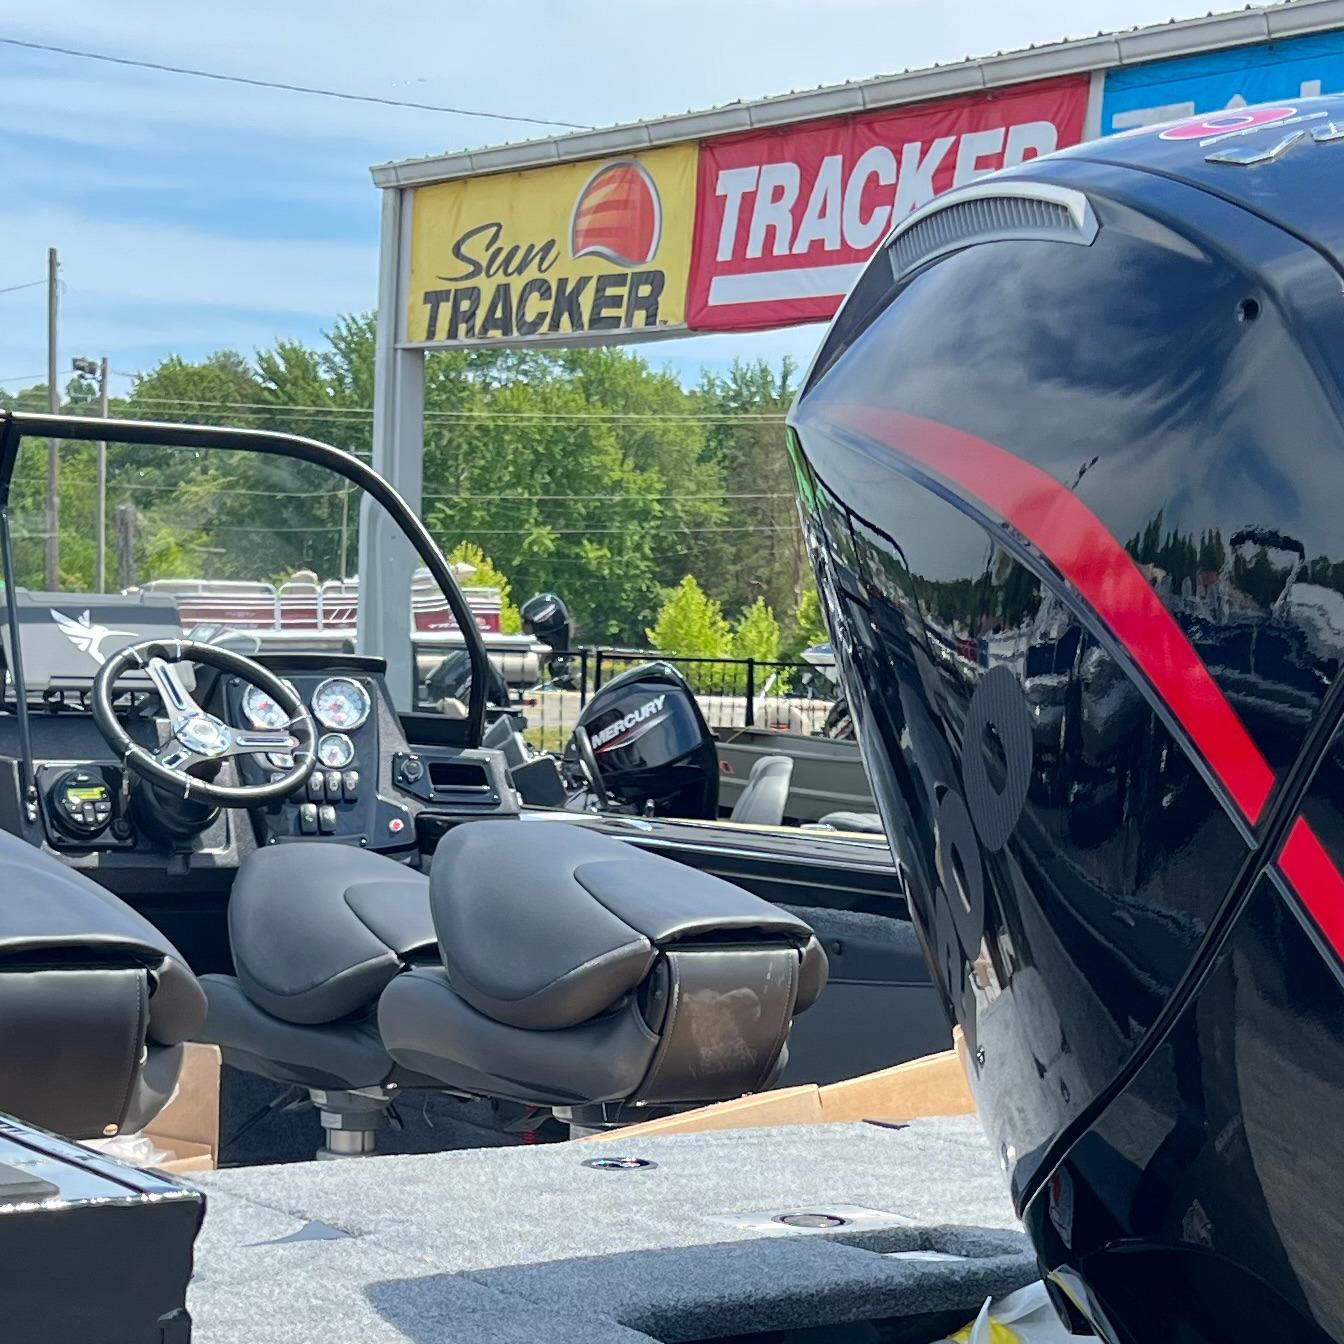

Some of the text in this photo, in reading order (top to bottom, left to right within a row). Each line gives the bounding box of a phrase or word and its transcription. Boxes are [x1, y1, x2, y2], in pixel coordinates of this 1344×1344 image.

[436, 222, 560, 282] Sun
[422, 270, 666, 341] TRACKER
[591, 694, 666, 749] MERCURY
